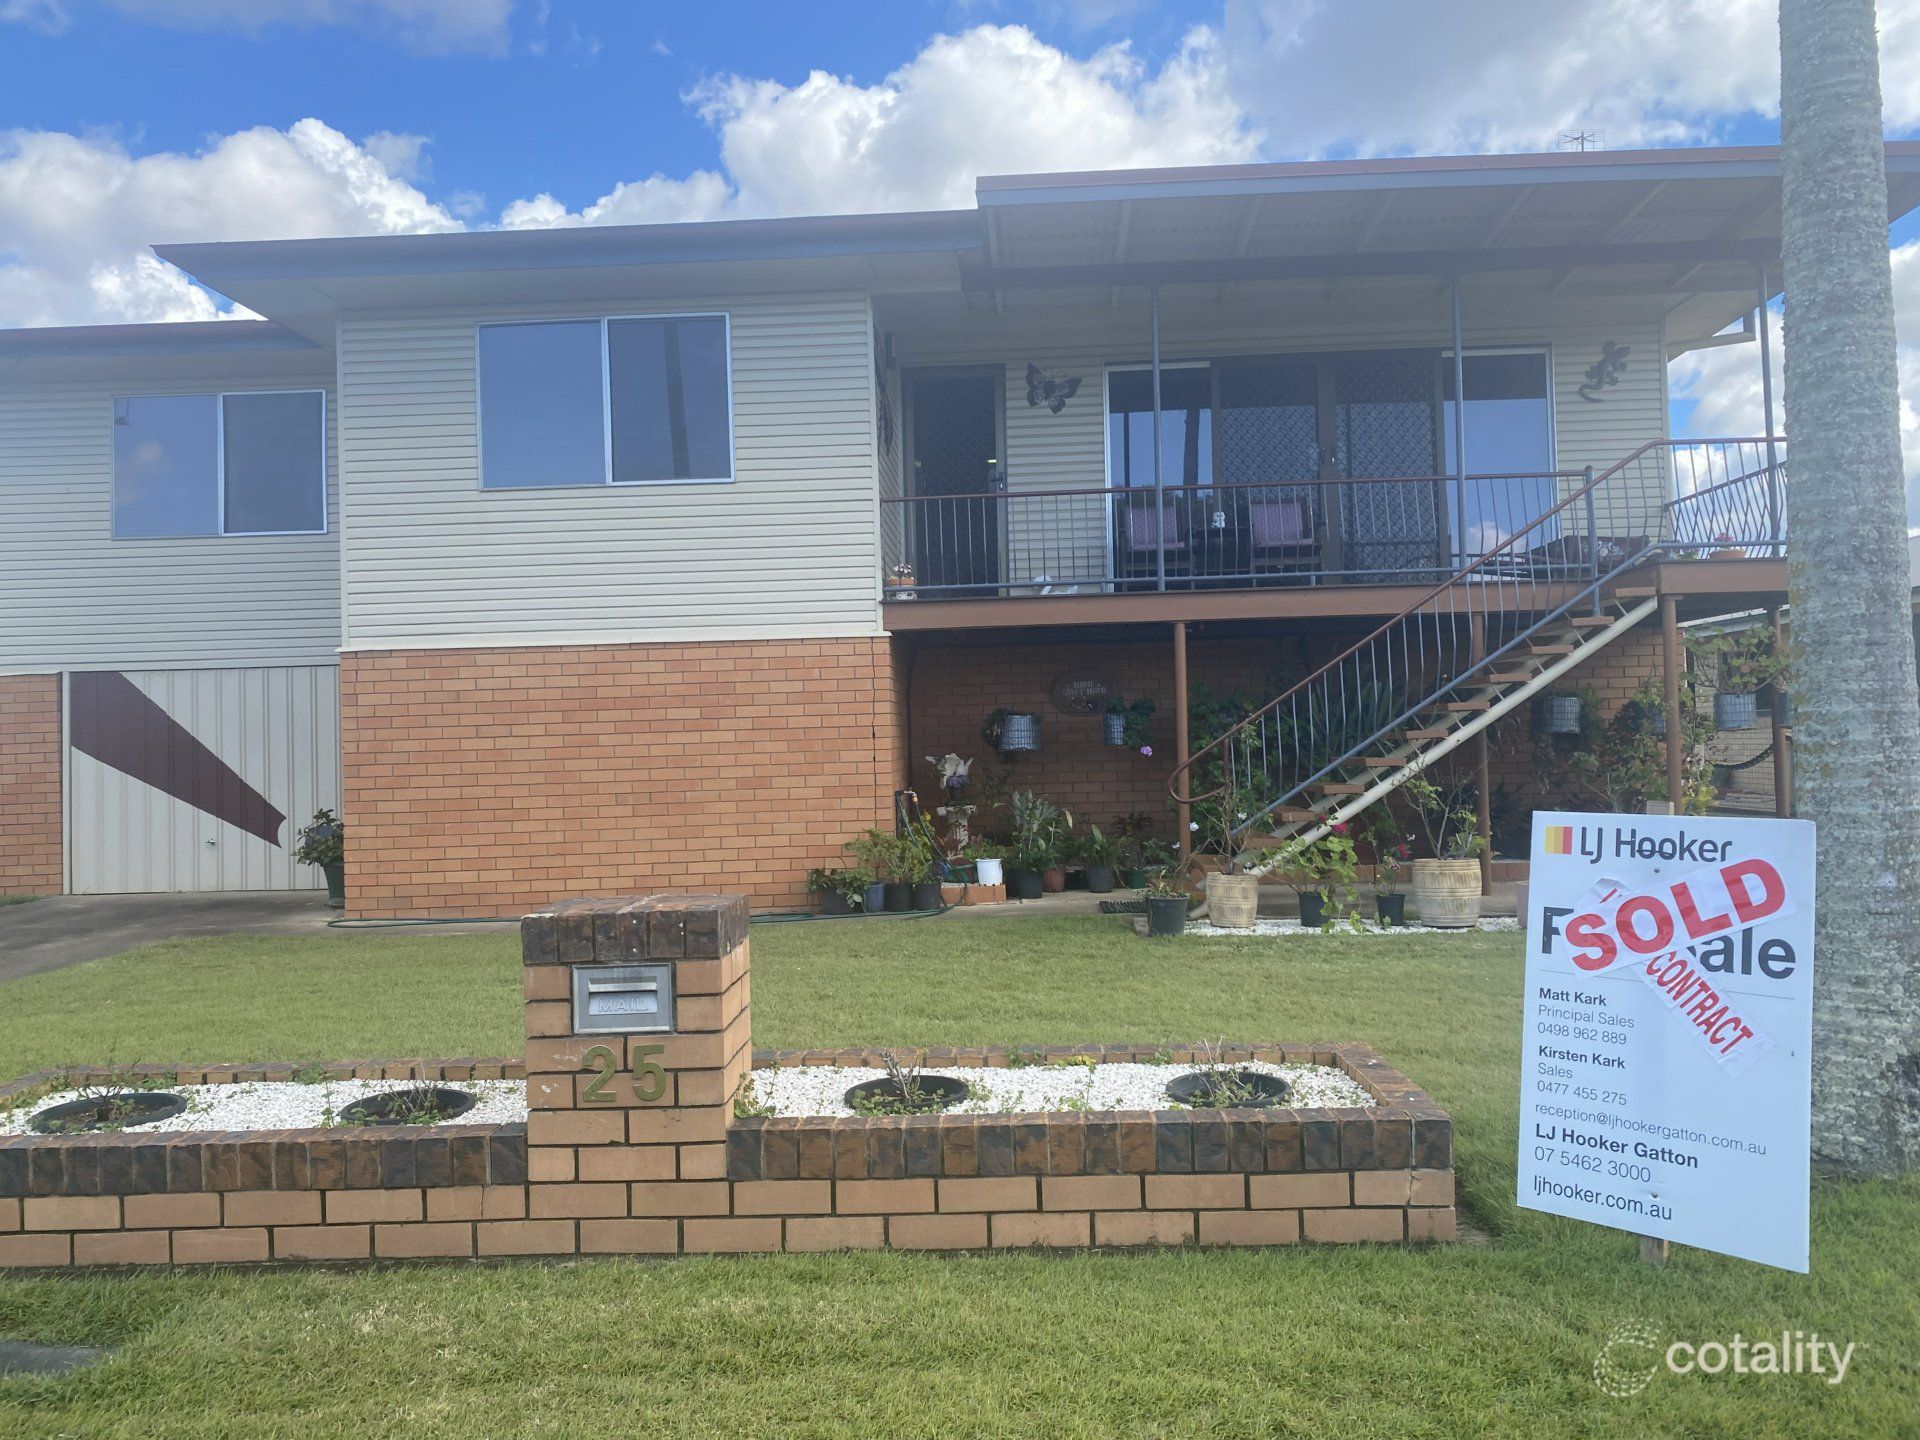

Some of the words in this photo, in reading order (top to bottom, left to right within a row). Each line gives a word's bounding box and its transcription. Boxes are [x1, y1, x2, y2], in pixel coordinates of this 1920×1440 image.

[1580, 826, 1603, 864] LJ
[1615, 828, 1733, 863] Hooker
[1565, 858, 1786, 971] SOLD
[1686, 927, 1797, 980] ale
[598, 996, 650, 1013] MAIL
[1539, 987, 1571, 1002] Matt
[1574, 991, 1607, 1007] Kark
[1646, 951, 1754, 1055] CONTRACT
[1537, 1021, 1570, 1037] 0498
[1573, 1026, 1598, 1041] 962
[1601, 1031, 1627, 1045] 889
[1538, 1004, 1594, 1023] Principal
[1598, 1012, 1635, 1029] Sales
[583, 1044, 667, 1103] 25
[1537, 1062, 1573, 1079] Sales
[1538, 1045, 1588, 1064] Kirsten
[1592, 1053, 1626, 1070] Kark
[1537, 1080, 1570, 1096] 0477
[1573, 1086, 1598, 1101] 455
[1601, 1090, 1627, 1106] 275
[1535, 1103, 1767, 1155] reception@ljhookergatton.com.au
[1535, 1123, 1556, 1140] LJ
[1562, 1127, 1628, 1154] Hooker
[1633, 1142, 1699, 1169] Gatton
[1534, 1146, 1555, 1163] 07
[1560, 1150, 1603, 1173] 5462
[1607, 1160, 1651, 1183] 3000
[1534, 1175, 1673, 1221] ljhooker.com.au
